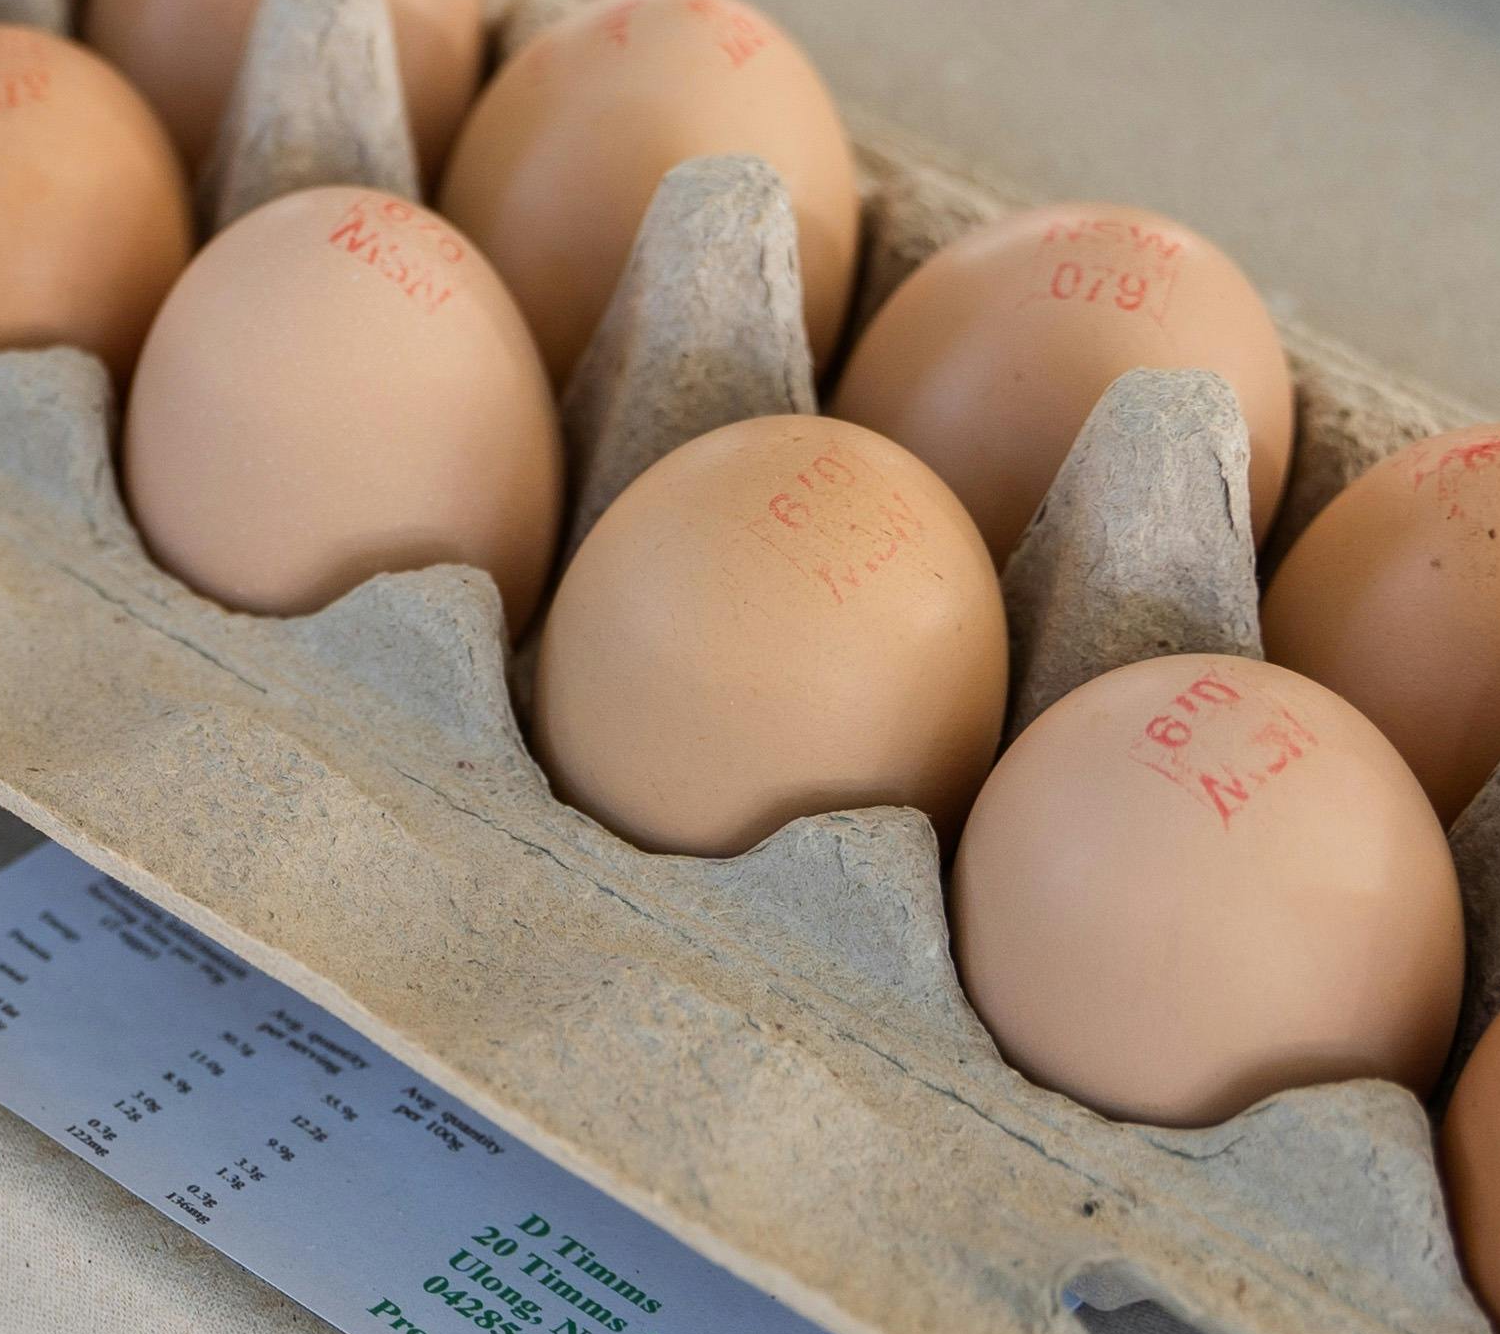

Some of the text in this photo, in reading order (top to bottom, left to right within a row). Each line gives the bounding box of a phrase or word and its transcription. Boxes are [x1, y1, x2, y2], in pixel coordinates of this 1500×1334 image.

[448, 1248, 543, 1326] Ulong,
[471, 1225, 519, 1257] 20
[520, 1252, 629, 1333] Timms
[517, 1213, 663, 1314] D Timms
